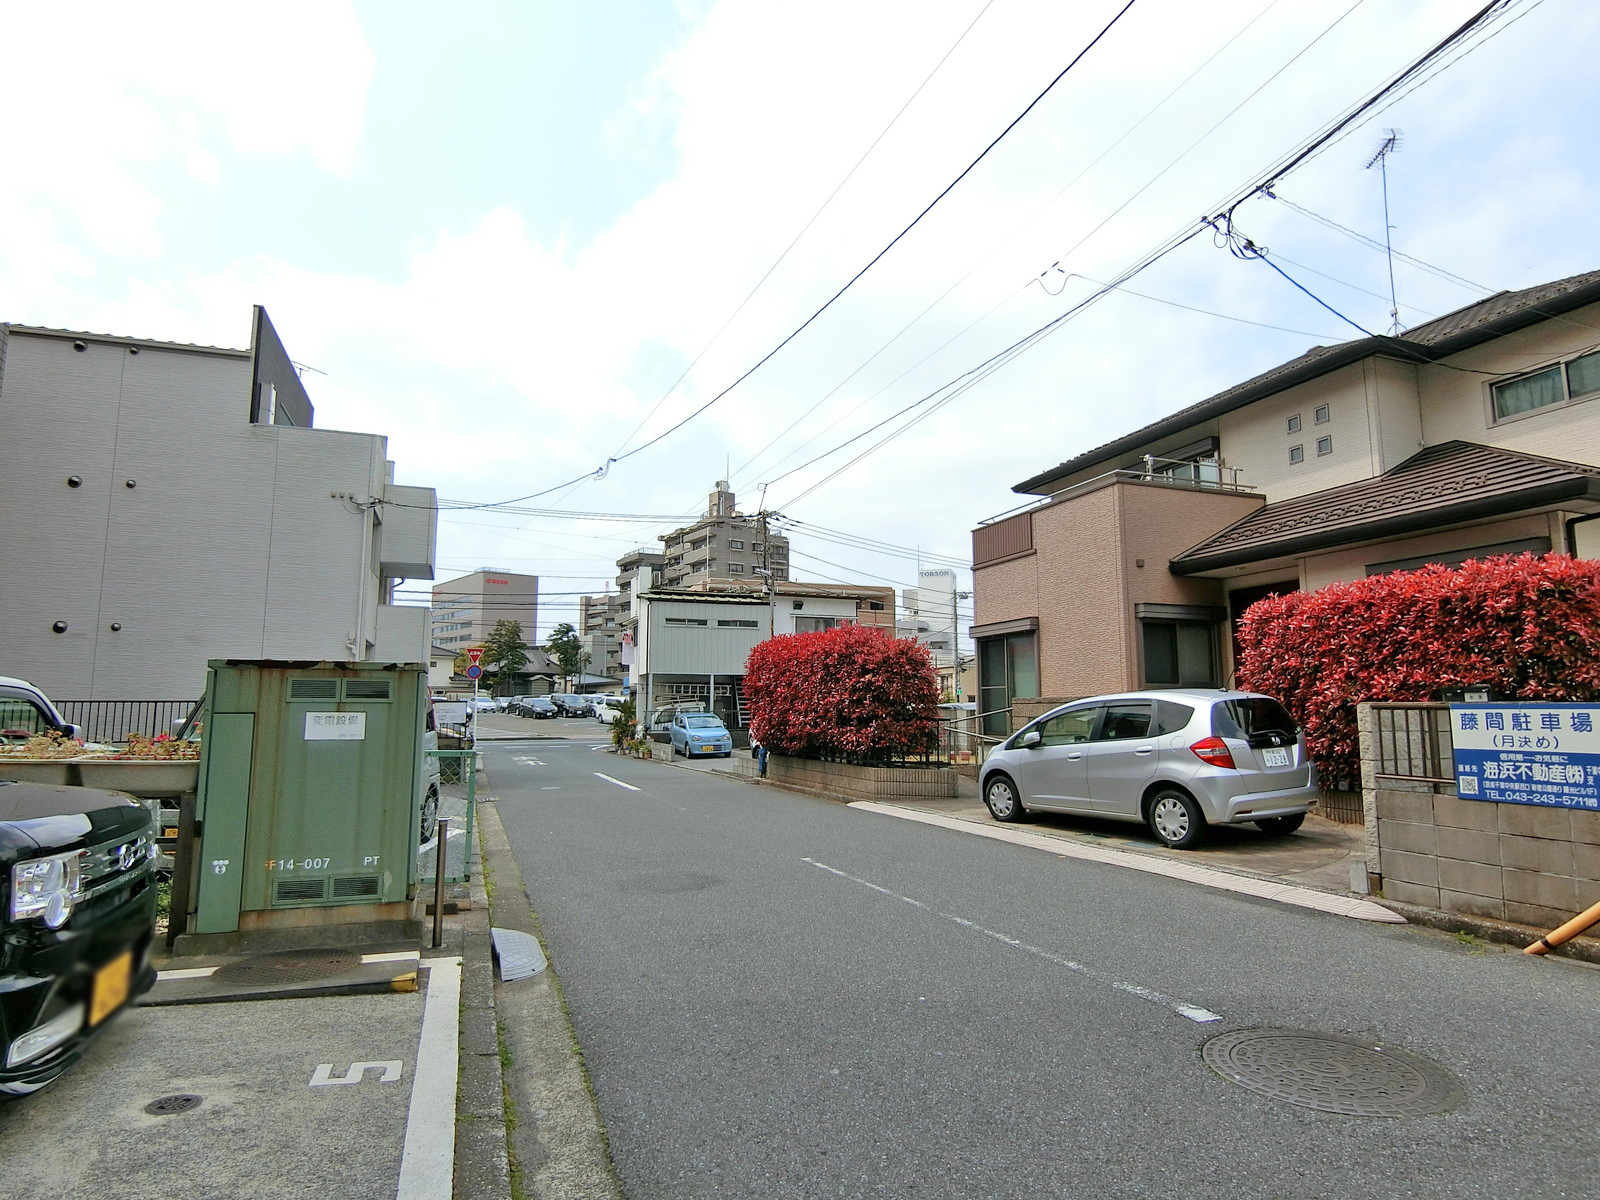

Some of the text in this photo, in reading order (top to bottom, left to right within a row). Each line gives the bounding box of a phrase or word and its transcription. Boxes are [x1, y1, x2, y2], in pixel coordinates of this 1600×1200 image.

[312, 715, 360, 726] 変電設備
[1459, 711, 1593, 733] 藤間駐車場
[1492, 734, 1560, 749] (月決め)
[364, 856, 381, 866] PT
[308, 1059, 404, 1087] 5
